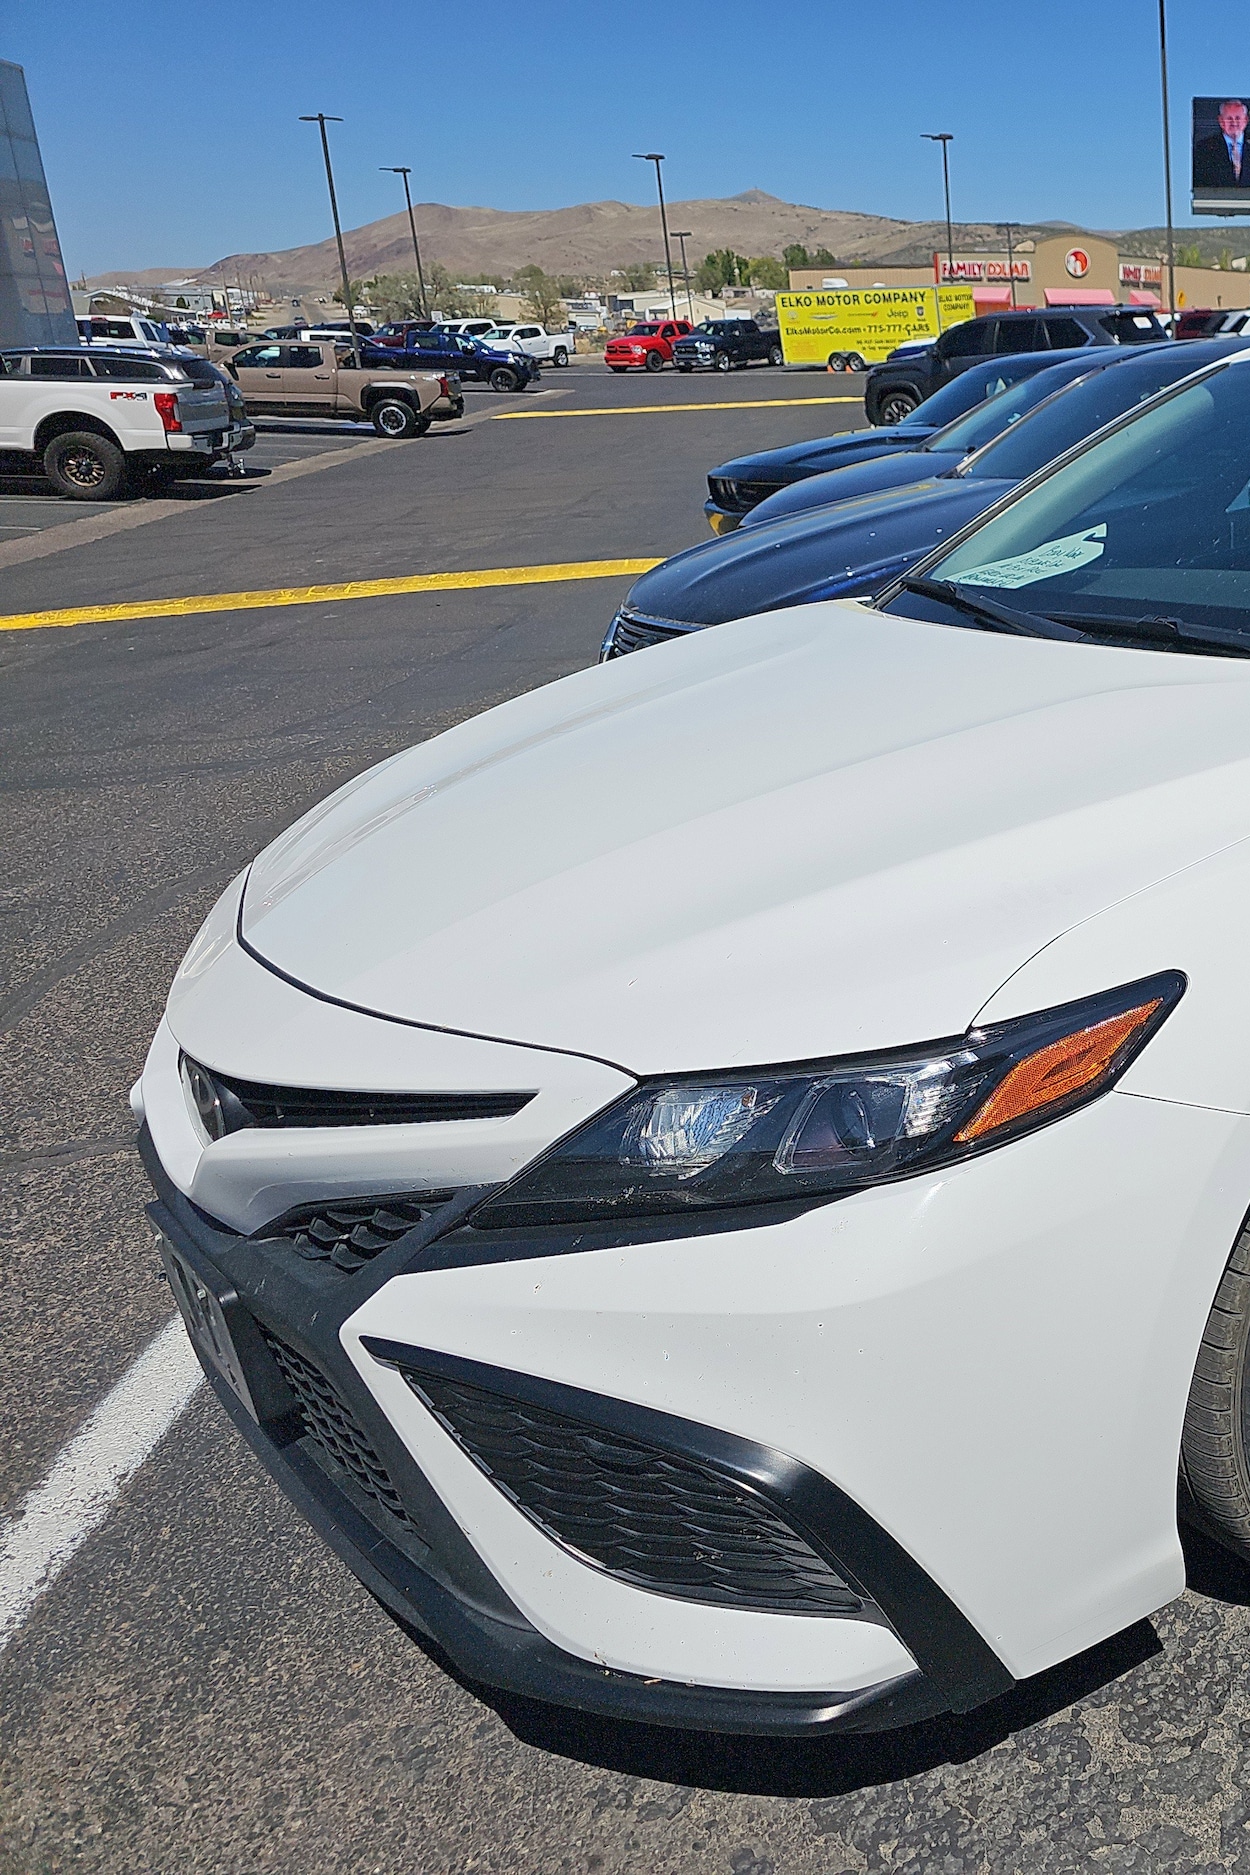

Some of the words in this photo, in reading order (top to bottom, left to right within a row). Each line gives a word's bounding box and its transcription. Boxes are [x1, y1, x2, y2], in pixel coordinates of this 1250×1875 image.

[942, 262, 983, 275] FAMILY
[988, 263, 1029, 276] DOLLAR
[781, 296, 812, 308] ELKO
[816, 294, 860, 307] MOTOR
[864, 291, 926, 305] COMPANY
[111, 391, 148, 401] FX4
